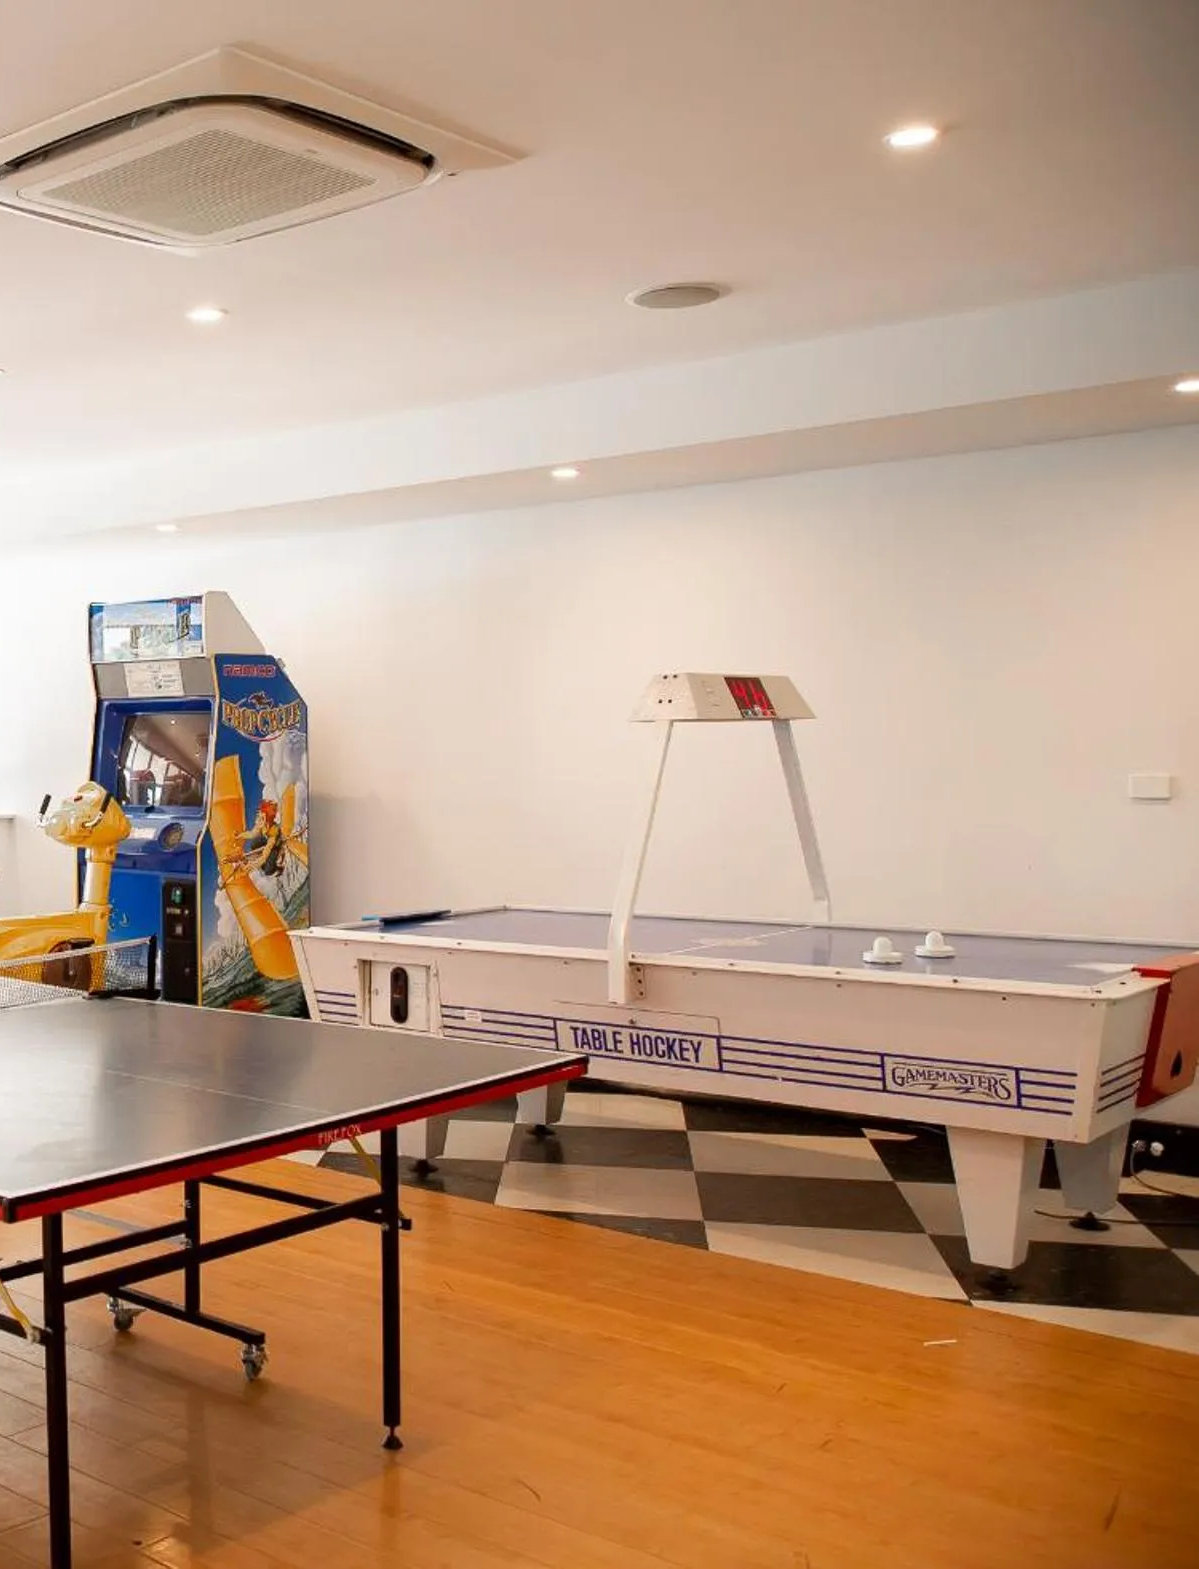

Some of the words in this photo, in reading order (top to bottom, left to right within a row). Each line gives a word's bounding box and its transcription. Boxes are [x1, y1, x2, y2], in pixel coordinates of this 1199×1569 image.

[570, 1026, 624, 1054] TABLE
[629, 1033, 702, 1063] HOCKEY
[891, 1066, 1011, 1100] GAMEMASTERS
